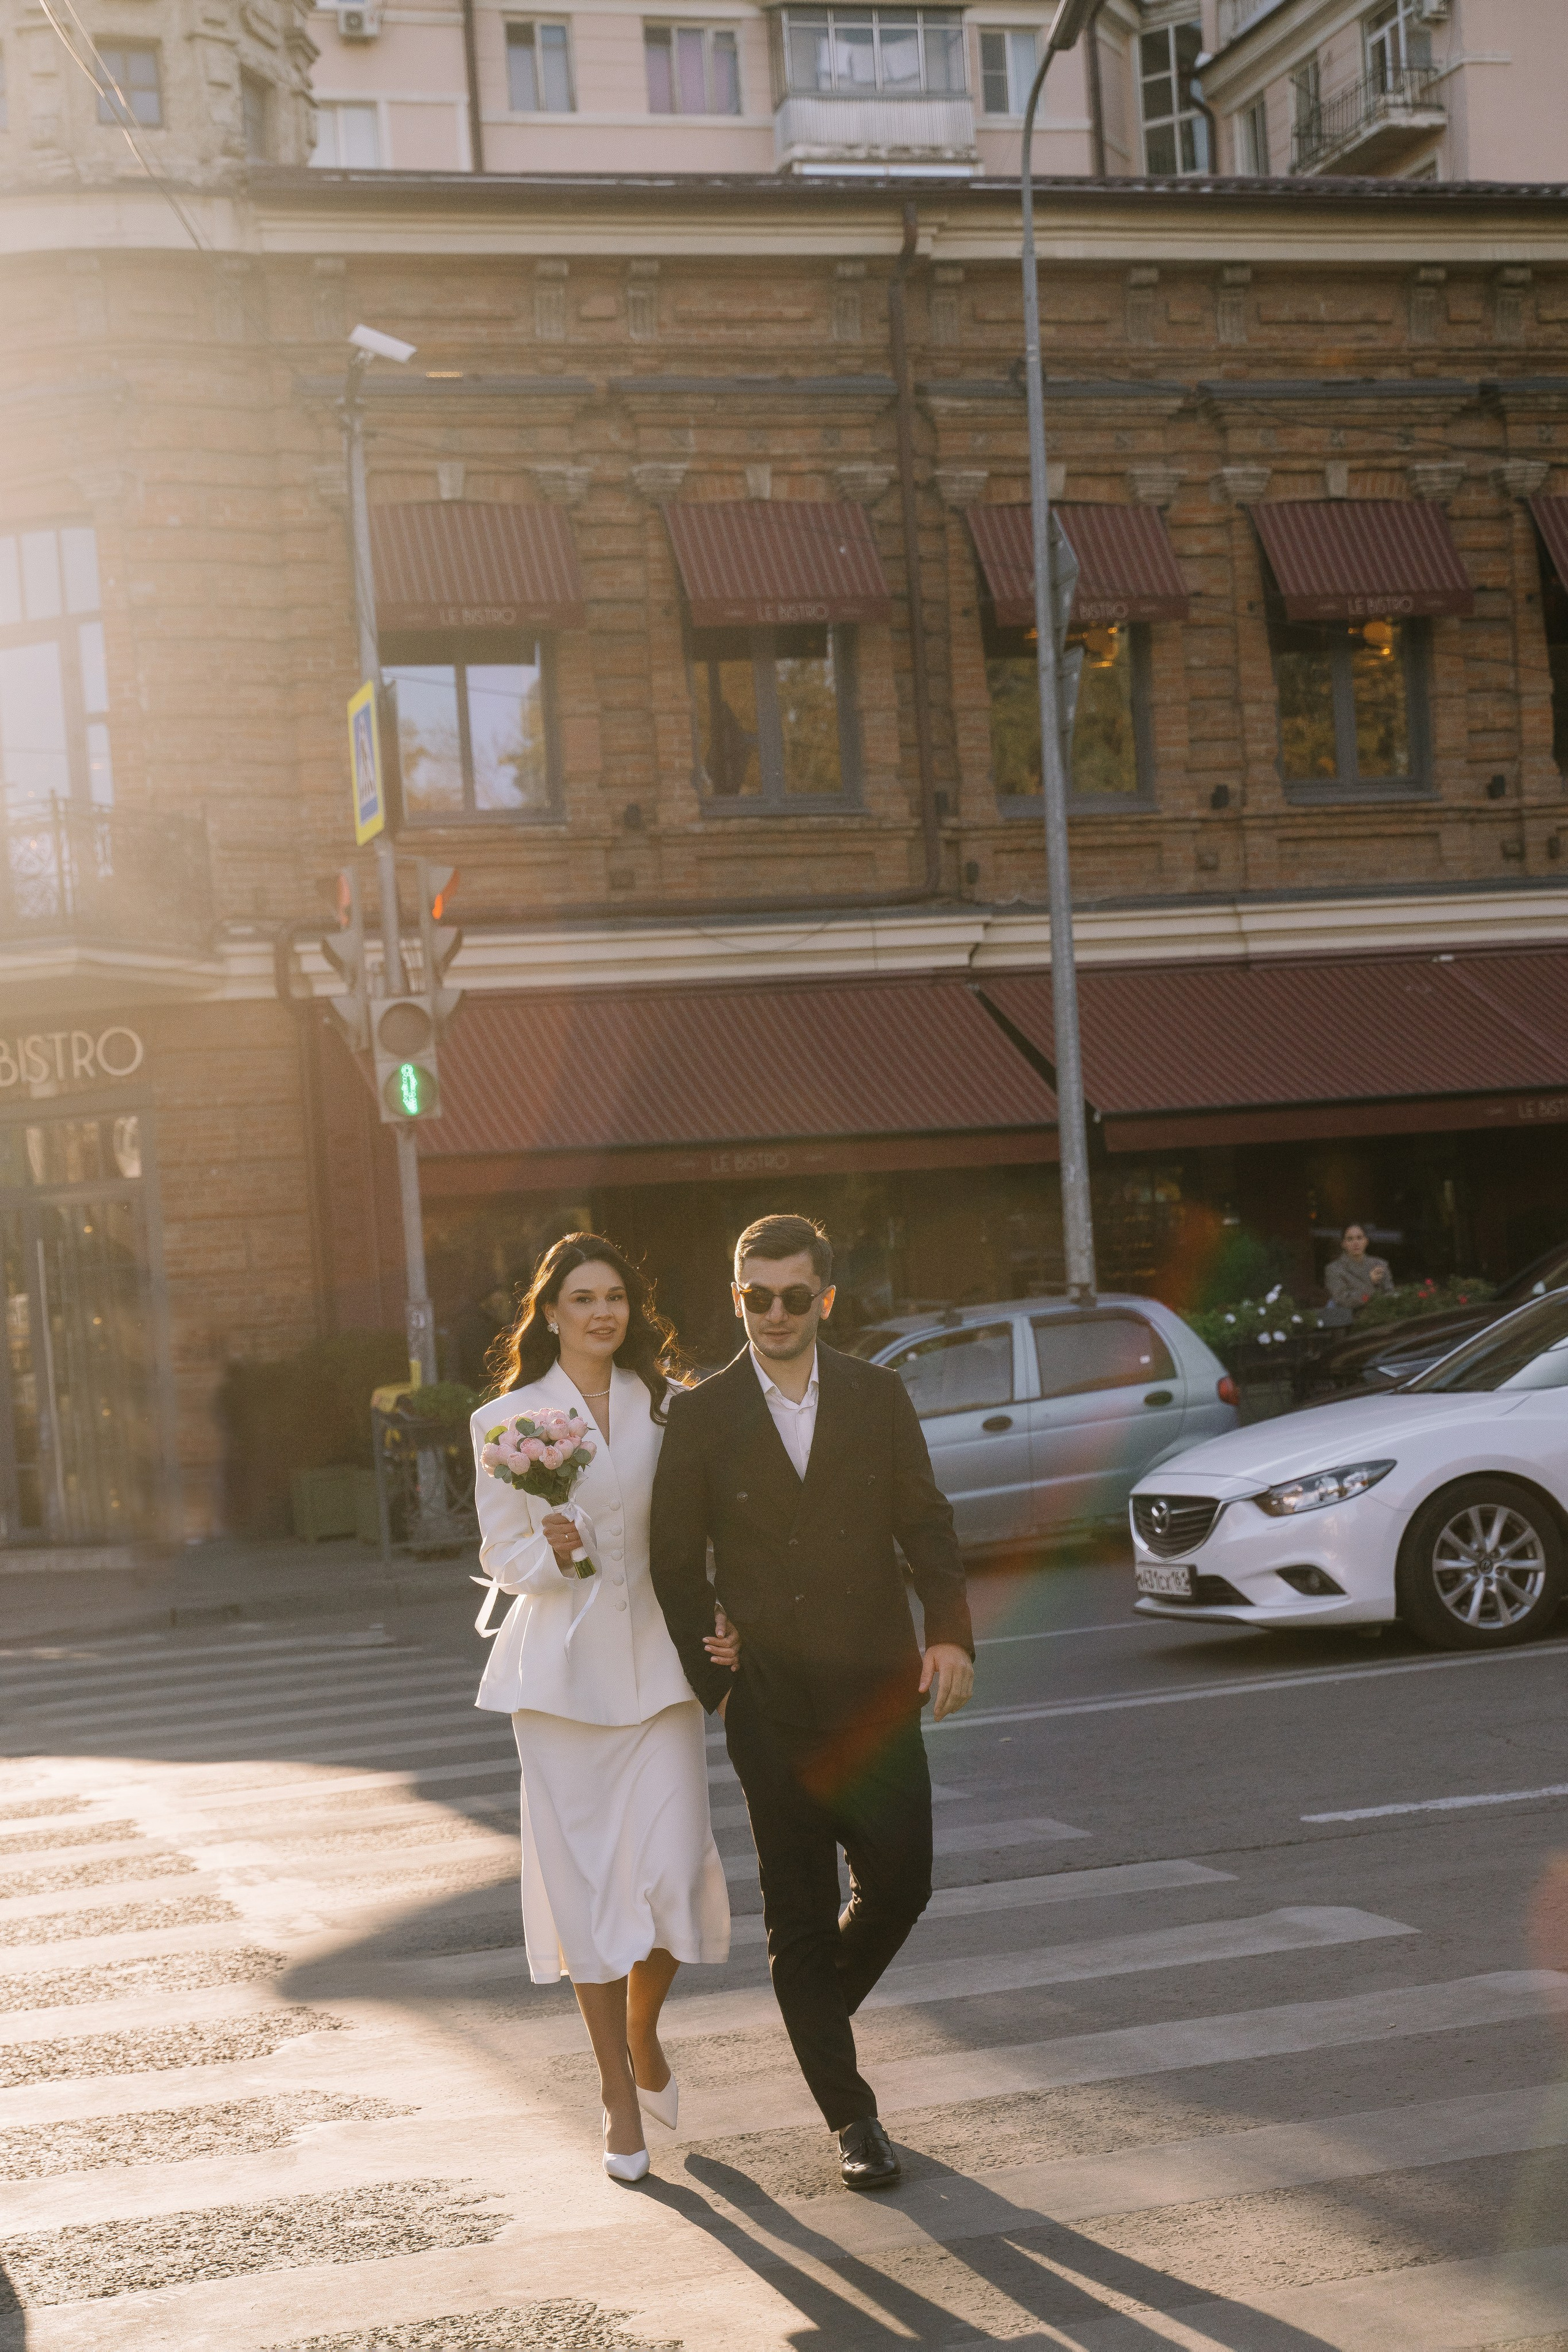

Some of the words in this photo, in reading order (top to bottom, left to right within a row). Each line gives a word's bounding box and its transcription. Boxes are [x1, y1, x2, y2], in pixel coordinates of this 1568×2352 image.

[757, 603, 775, 621] LE
[778, 602, 829, 620] BISTRO
[1079, 601, 1128, 620] BISTRO
[1348, 597, 1364, 615] LE
[1366, 595, 1414, 614] BISTRO
[439, 608, 458, 625] LE
[462, 606, 516, 625] BISTRO
[710, 1154, 729, 1173] LE
[734, 1150, 789, 1171] BISTRO
